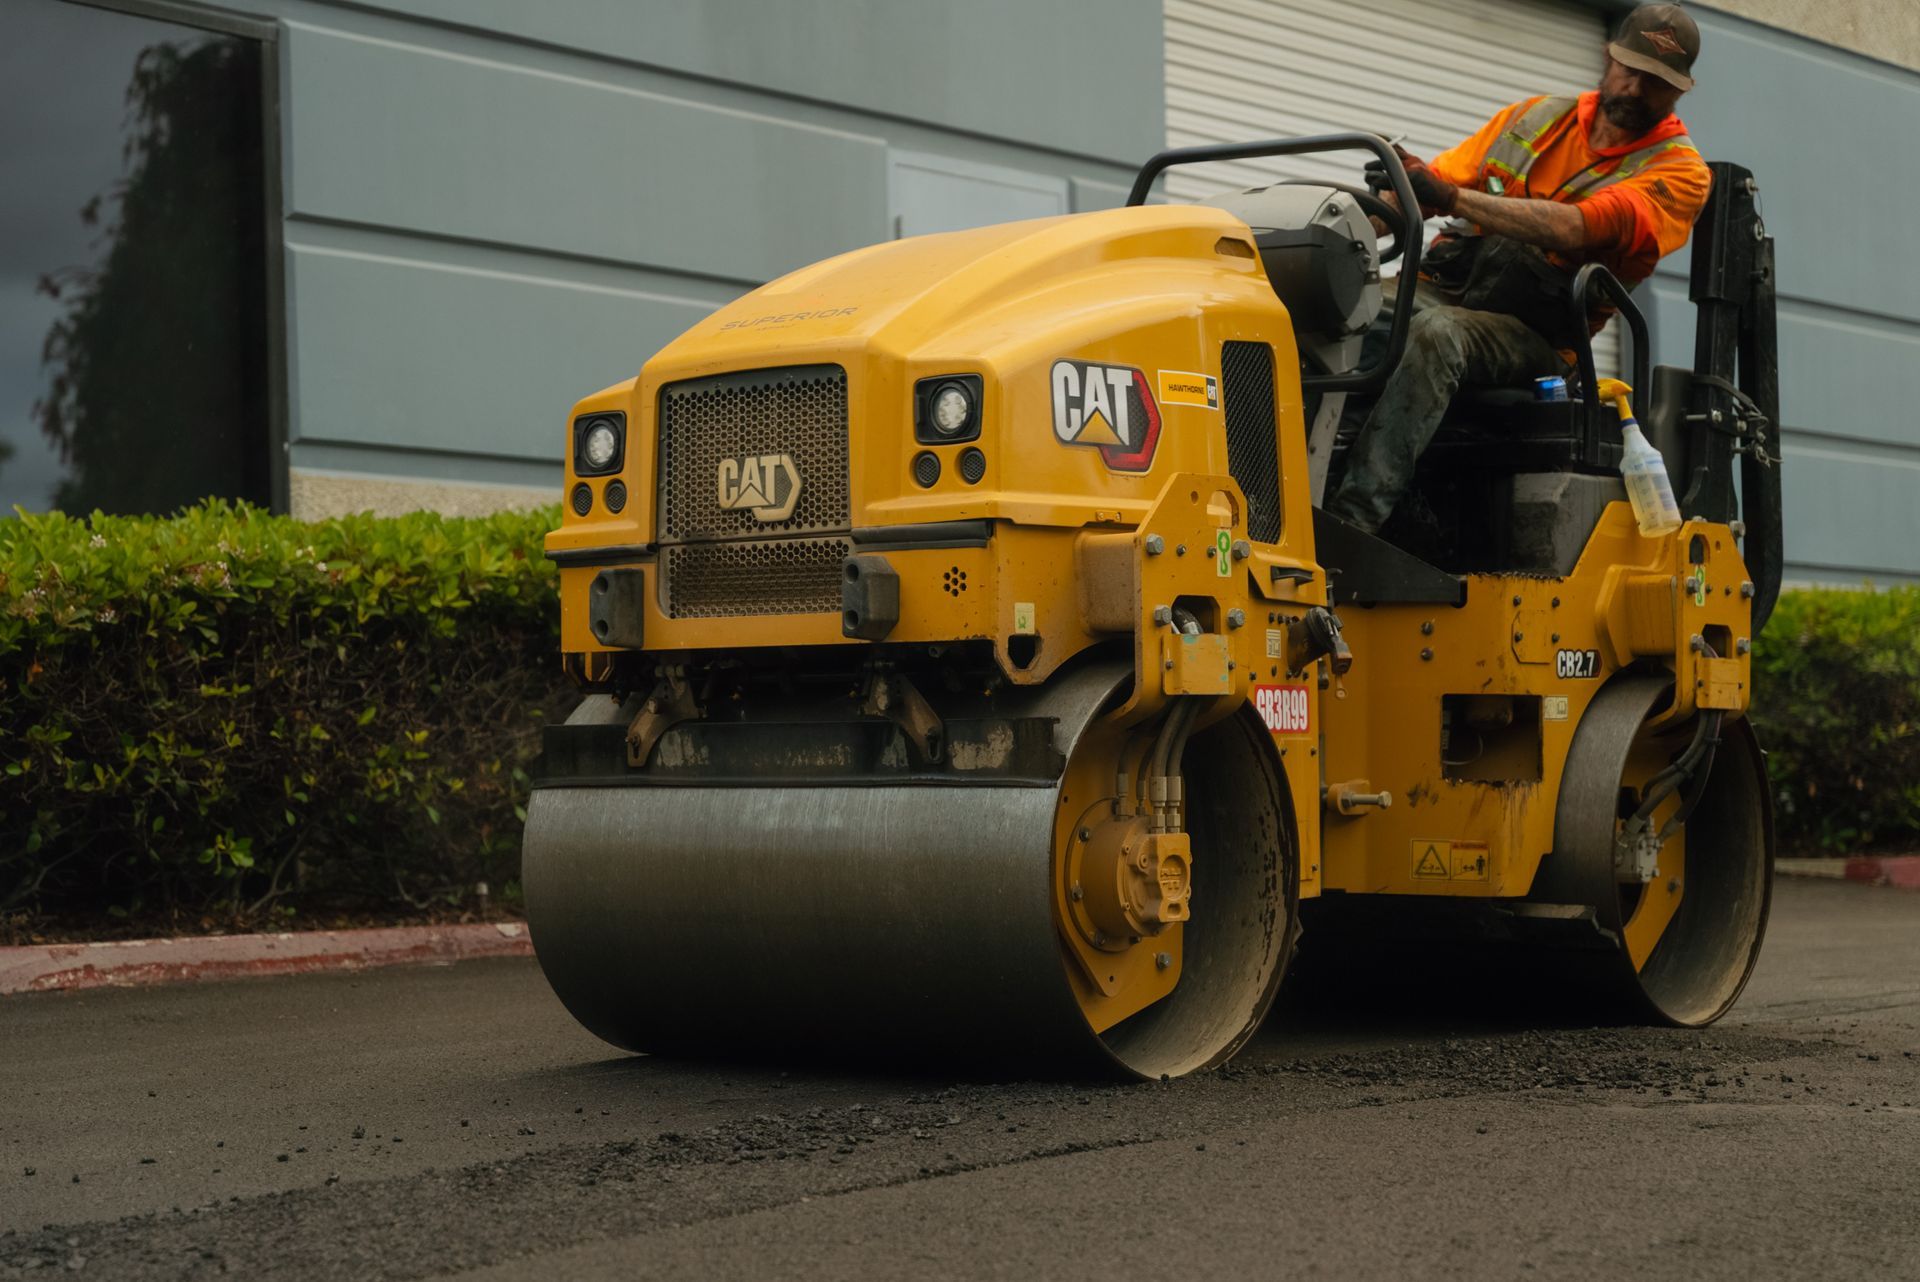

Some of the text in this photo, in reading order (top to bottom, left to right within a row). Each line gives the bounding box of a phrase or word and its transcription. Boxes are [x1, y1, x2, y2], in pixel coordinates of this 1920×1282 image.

[720, 307, 858, 331] SUPERIOR
[1168, 383, 1205, 395] HAWTHORNE
[1052, 361, 1134, 446] CAT
[718, 454, 781, 509] CAT
[1557, 650, 1595, 678] CB2.7
